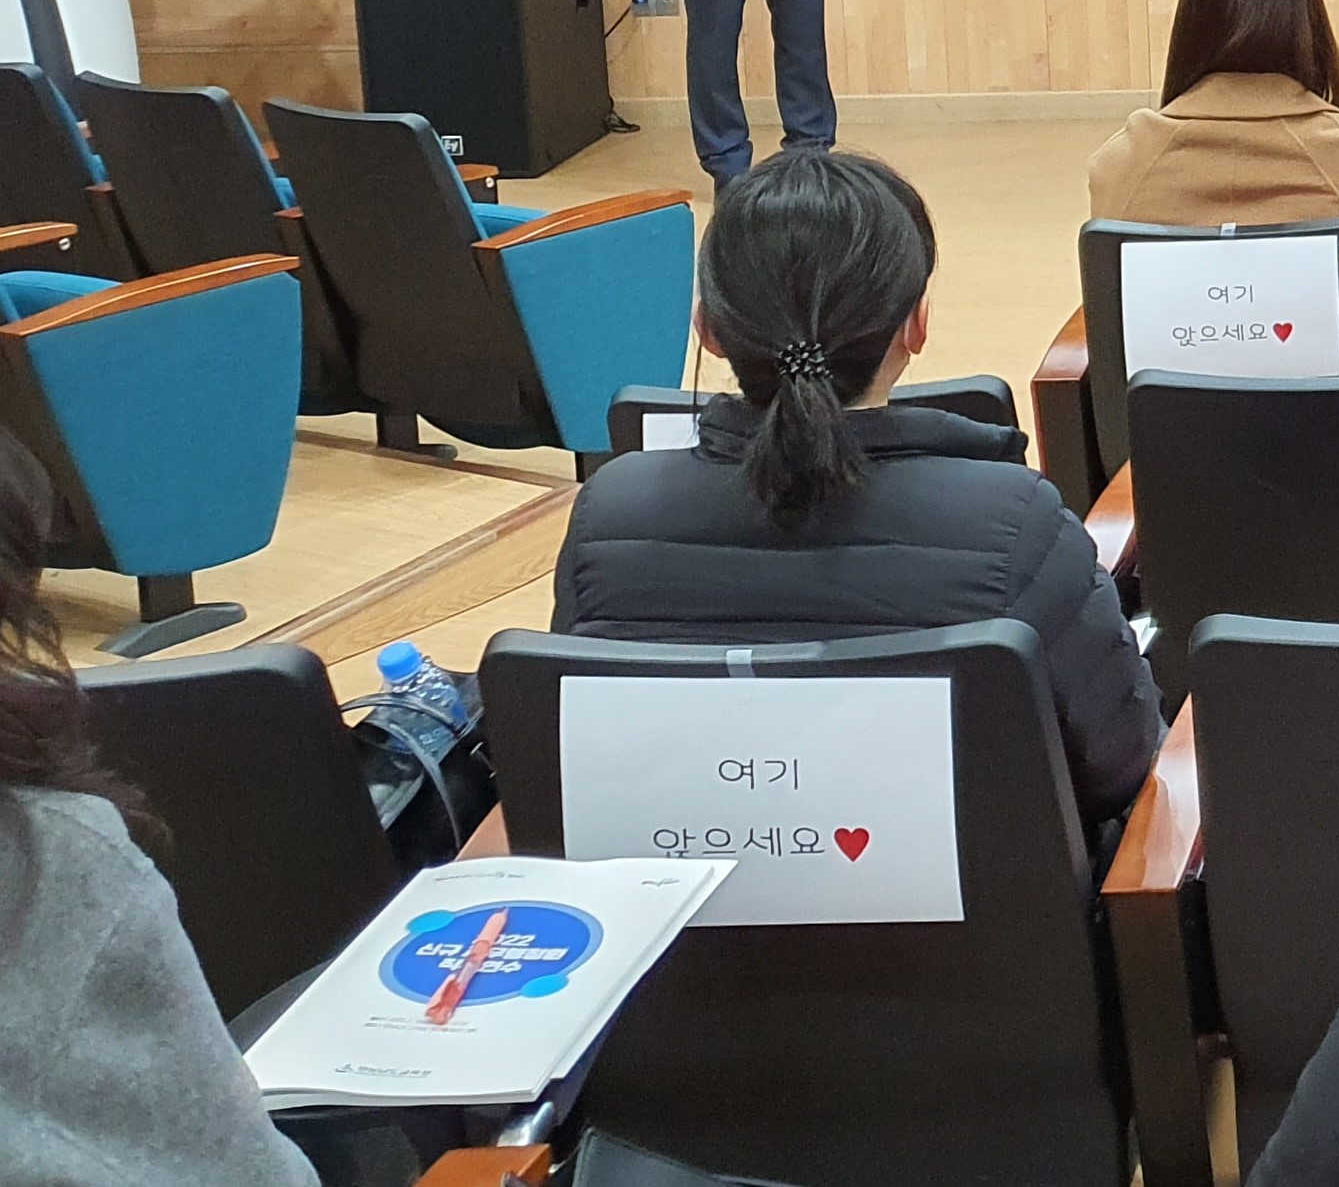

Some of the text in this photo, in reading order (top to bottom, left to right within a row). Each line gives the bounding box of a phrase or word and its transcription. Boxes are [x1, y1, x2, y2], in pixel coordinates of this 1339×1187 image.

[1207, 284, 1254, 304] 여기
[1172, 323, 1268, 347] 앉으세요
[718, 758, 799, 791] 여기
